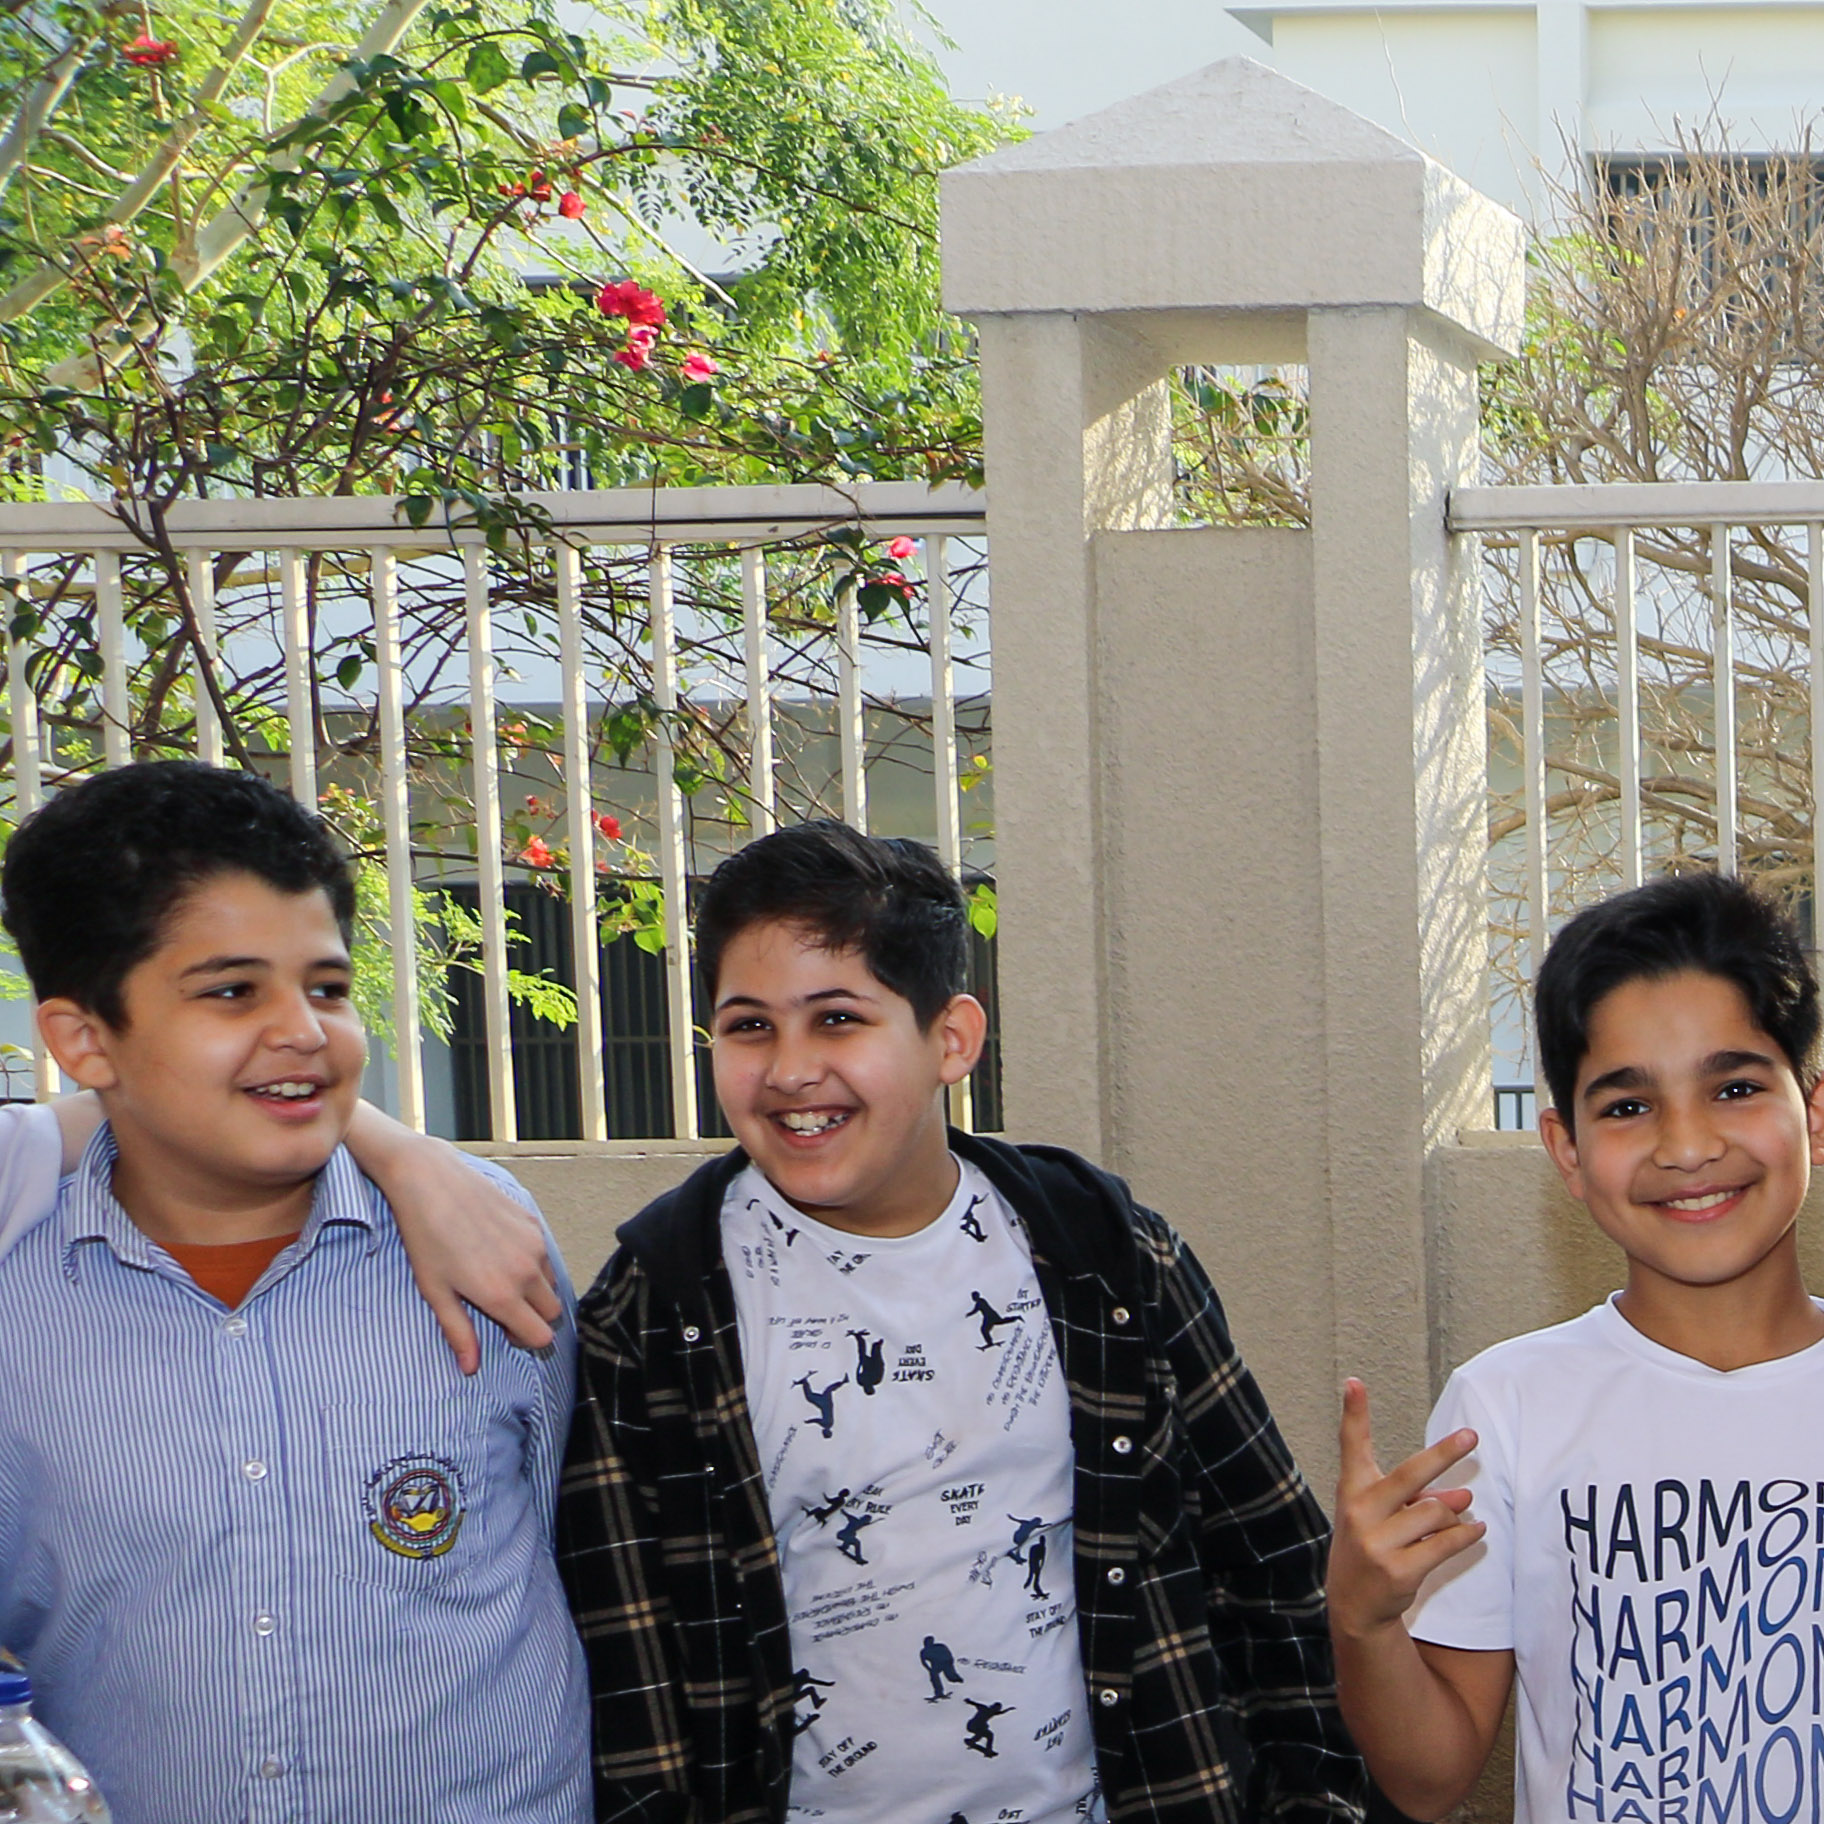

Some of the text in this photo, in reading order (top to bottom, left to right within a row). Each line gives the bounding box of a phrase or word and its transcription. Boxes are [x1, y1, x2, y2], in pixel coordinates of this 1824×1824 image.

[940, 1483, 985, 1502] SKATE
[950, 1500, 980, 1514] EVERY
[955, 1514, 973, 1527] DAY
[826, 1741, 878, 1780] THE GROUND
